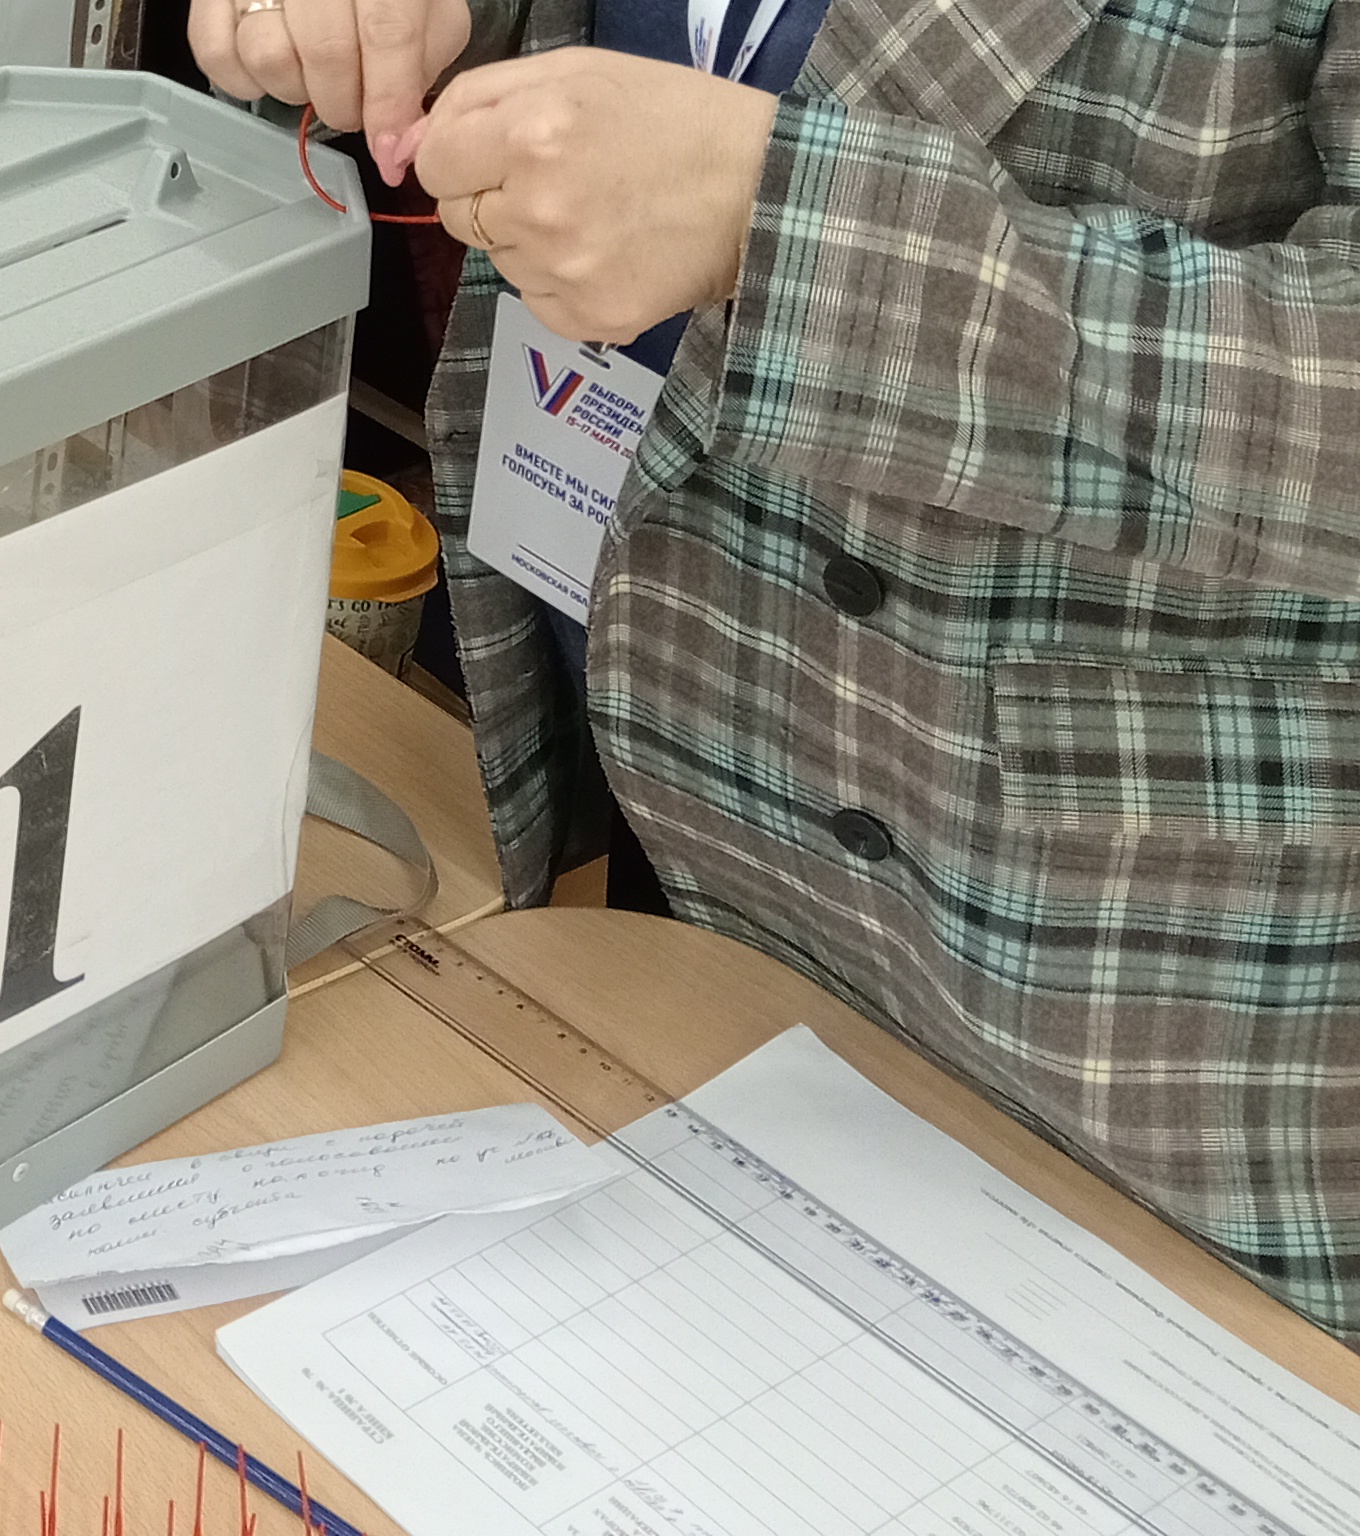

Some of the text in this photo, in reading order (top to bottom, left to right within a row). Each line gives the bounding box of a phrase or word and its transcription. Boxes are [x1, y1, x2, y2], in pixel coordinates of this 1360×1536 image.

[580, 394, 645, 436] ПРЕЗИДЕН
[588, 382, 646, 419] ВЫБОРЫ
[572, 405, 624, 439] РОССИИ
[589, 430, 621, 453] МАРТА
[620, 447, 635, 459] 20
[502, 454, 567, 503] ГОЛОСУЕМ
[569, 495, 584, 513] ЗА
[515, 442, 617, 511] ВМЕСТЕ МЫ СИЛ
[511, 554, 588, 607] МОСКОВСКАЯ ОБЛ
[351, 600, 370, 613] GO
[326, 1391, 386, 1446] СТРАНИЦА
